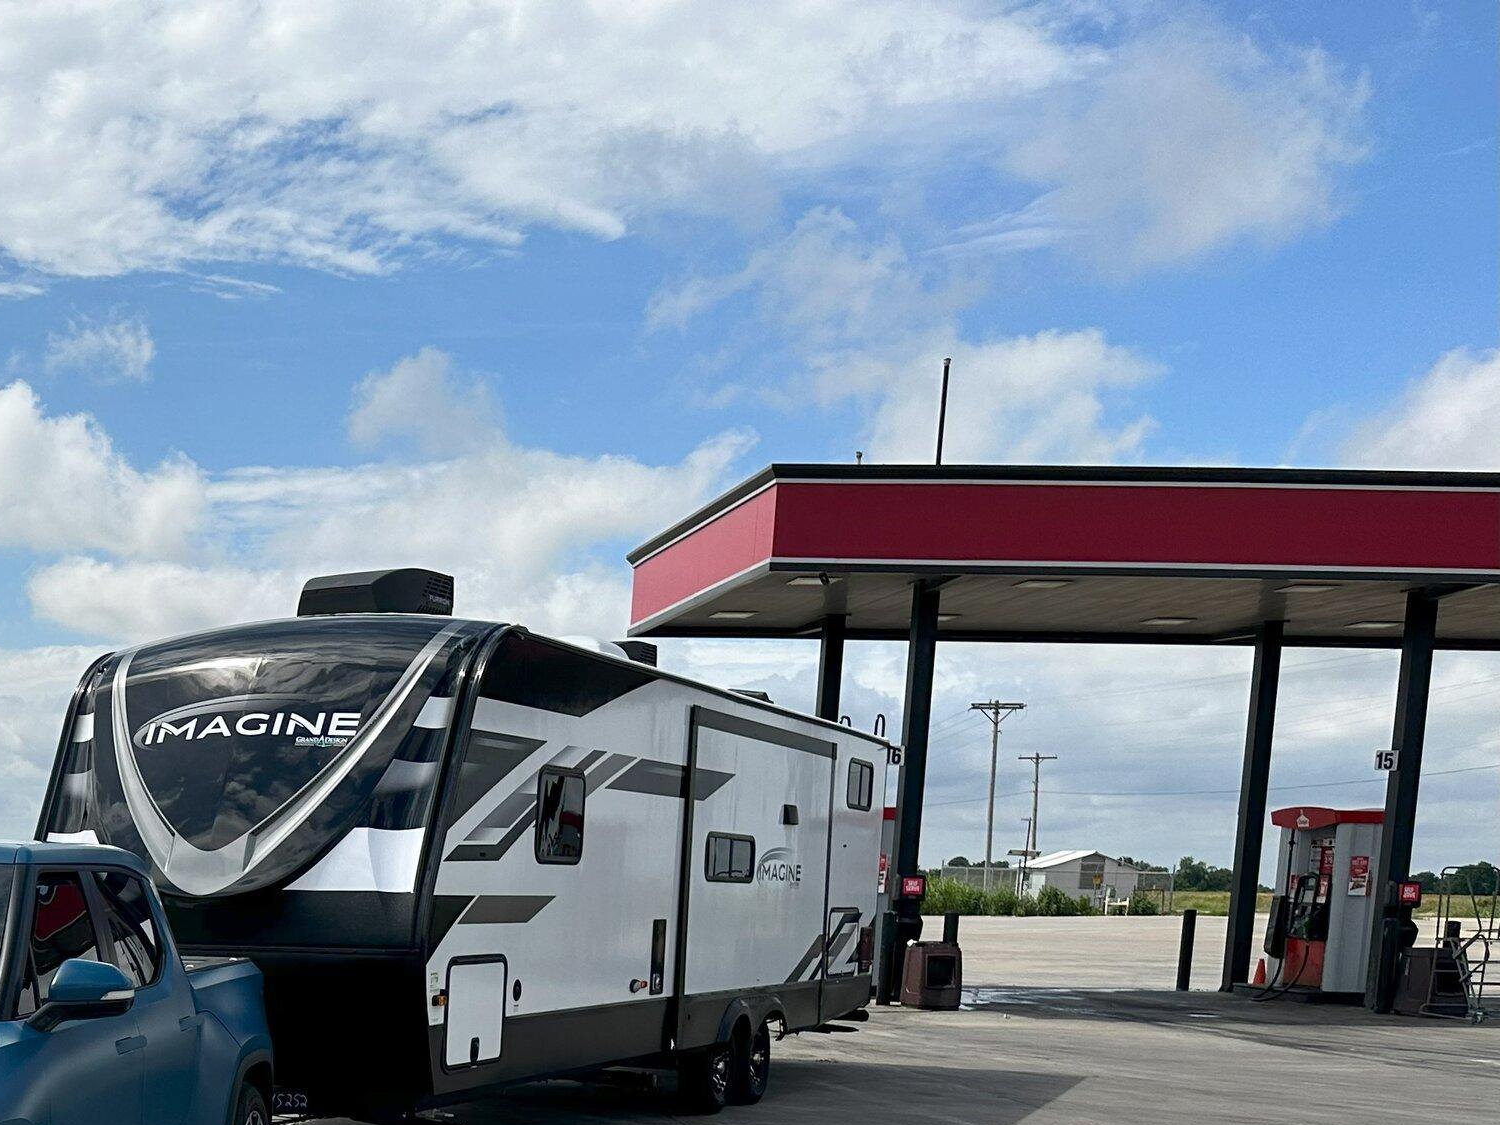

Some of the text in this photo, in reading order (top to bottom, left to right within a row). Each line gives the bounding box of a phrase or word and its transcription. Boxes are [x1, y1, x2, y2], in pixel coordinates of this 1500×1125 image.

[144, 712, 362, 745] IMAGINE
[1377, 752, 1394, 770] 15
[759, 863, 802, 882] IMAGINE
